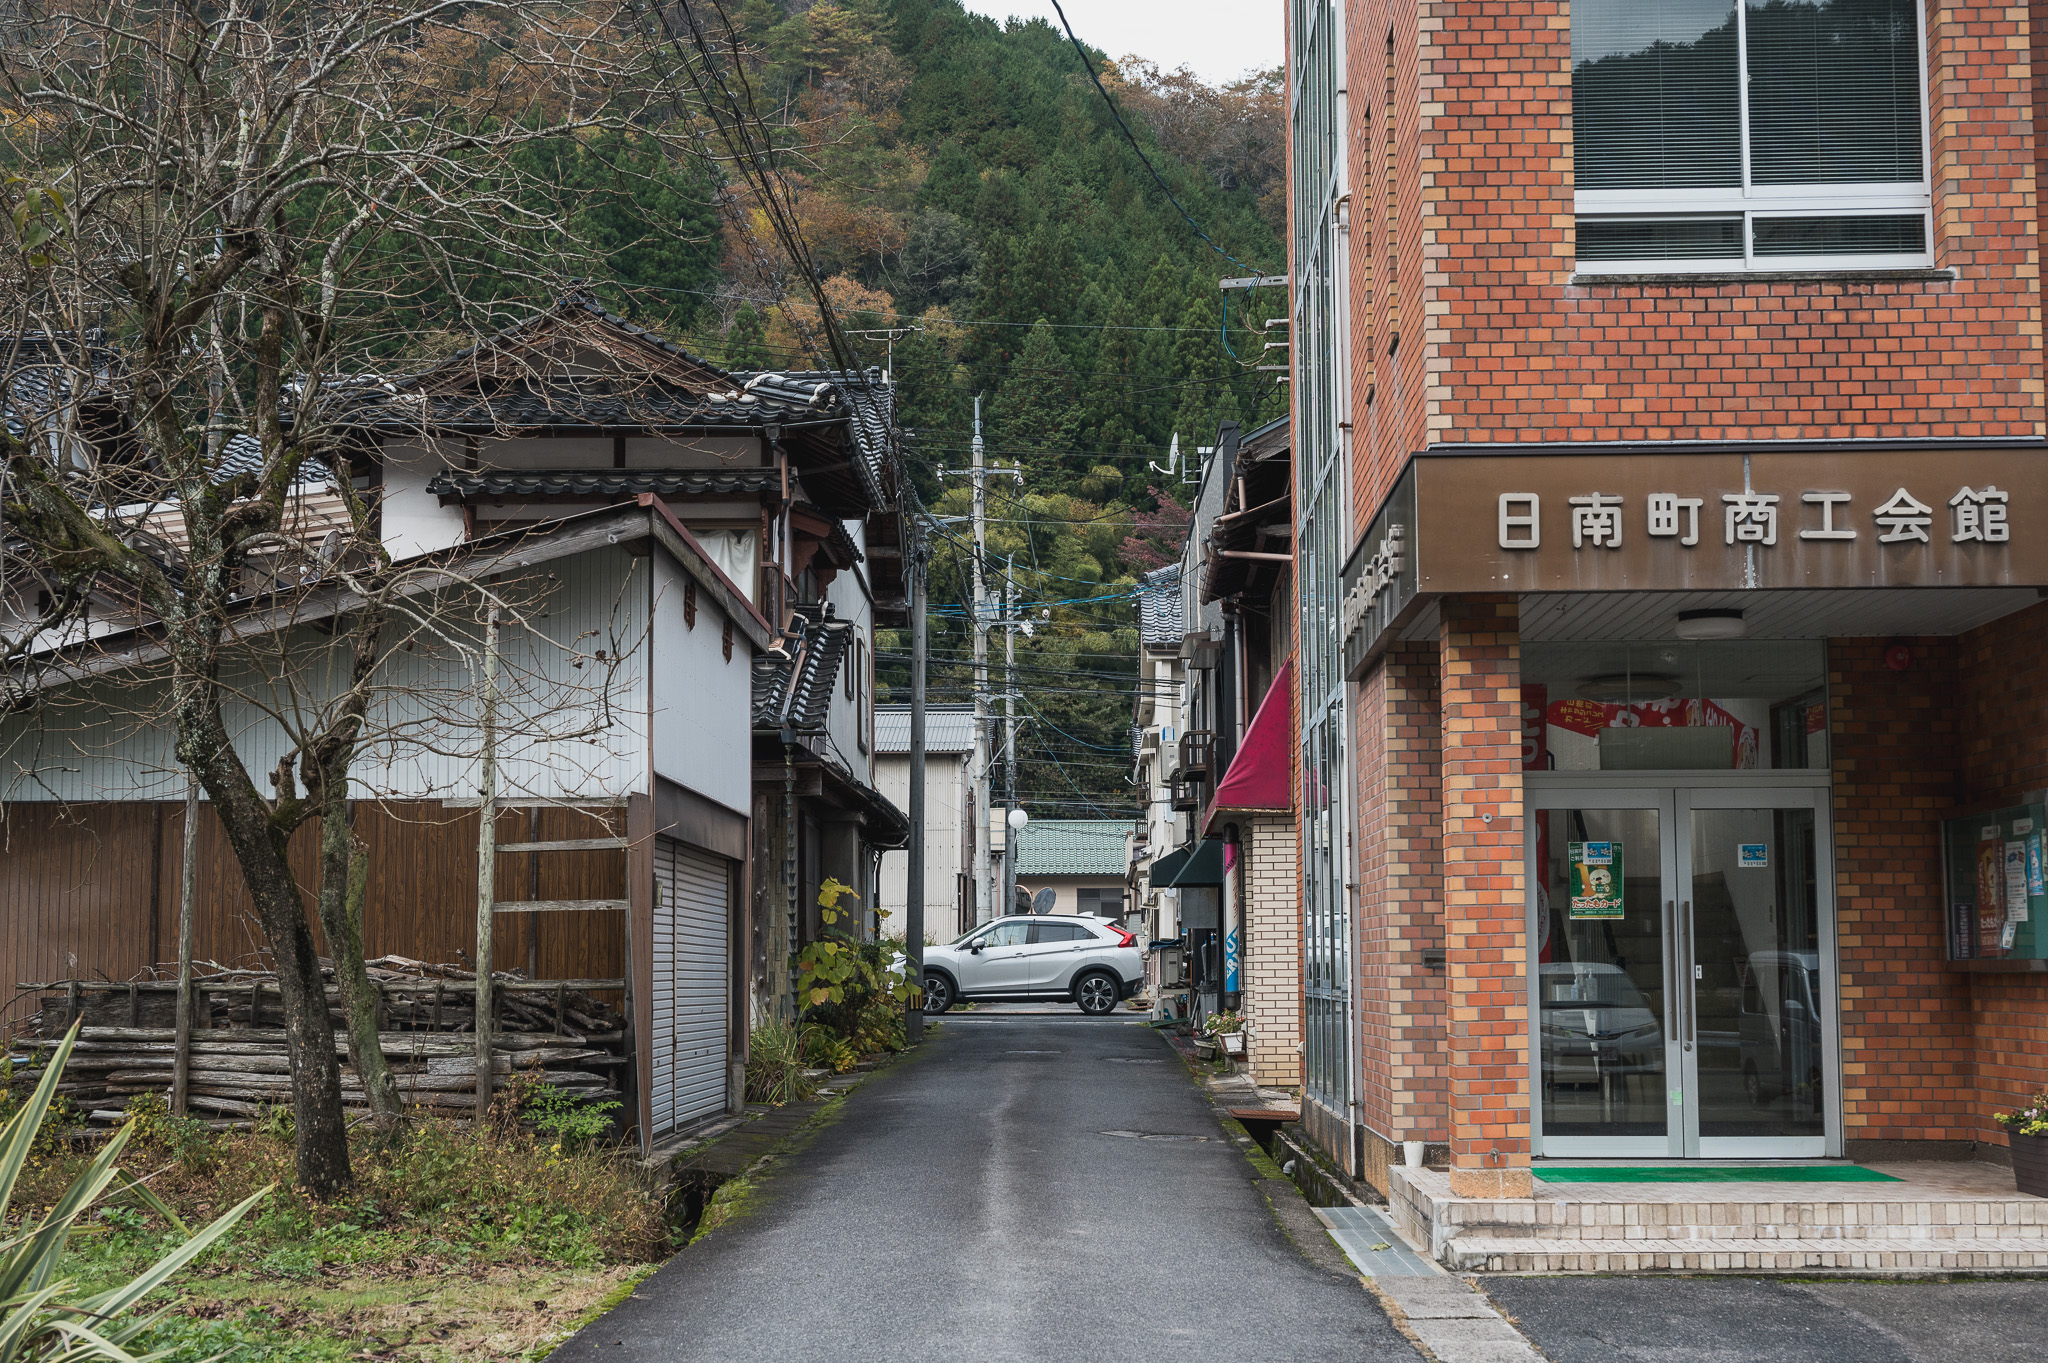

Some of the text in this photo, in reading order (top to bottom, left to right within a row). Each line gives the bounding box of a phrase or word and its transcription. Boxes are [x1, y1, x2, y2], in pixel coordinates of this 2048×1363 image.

[1497, 485, 2010, 549] 日南町商工会館
[1572, 898, 1621, 908] たったもカード
